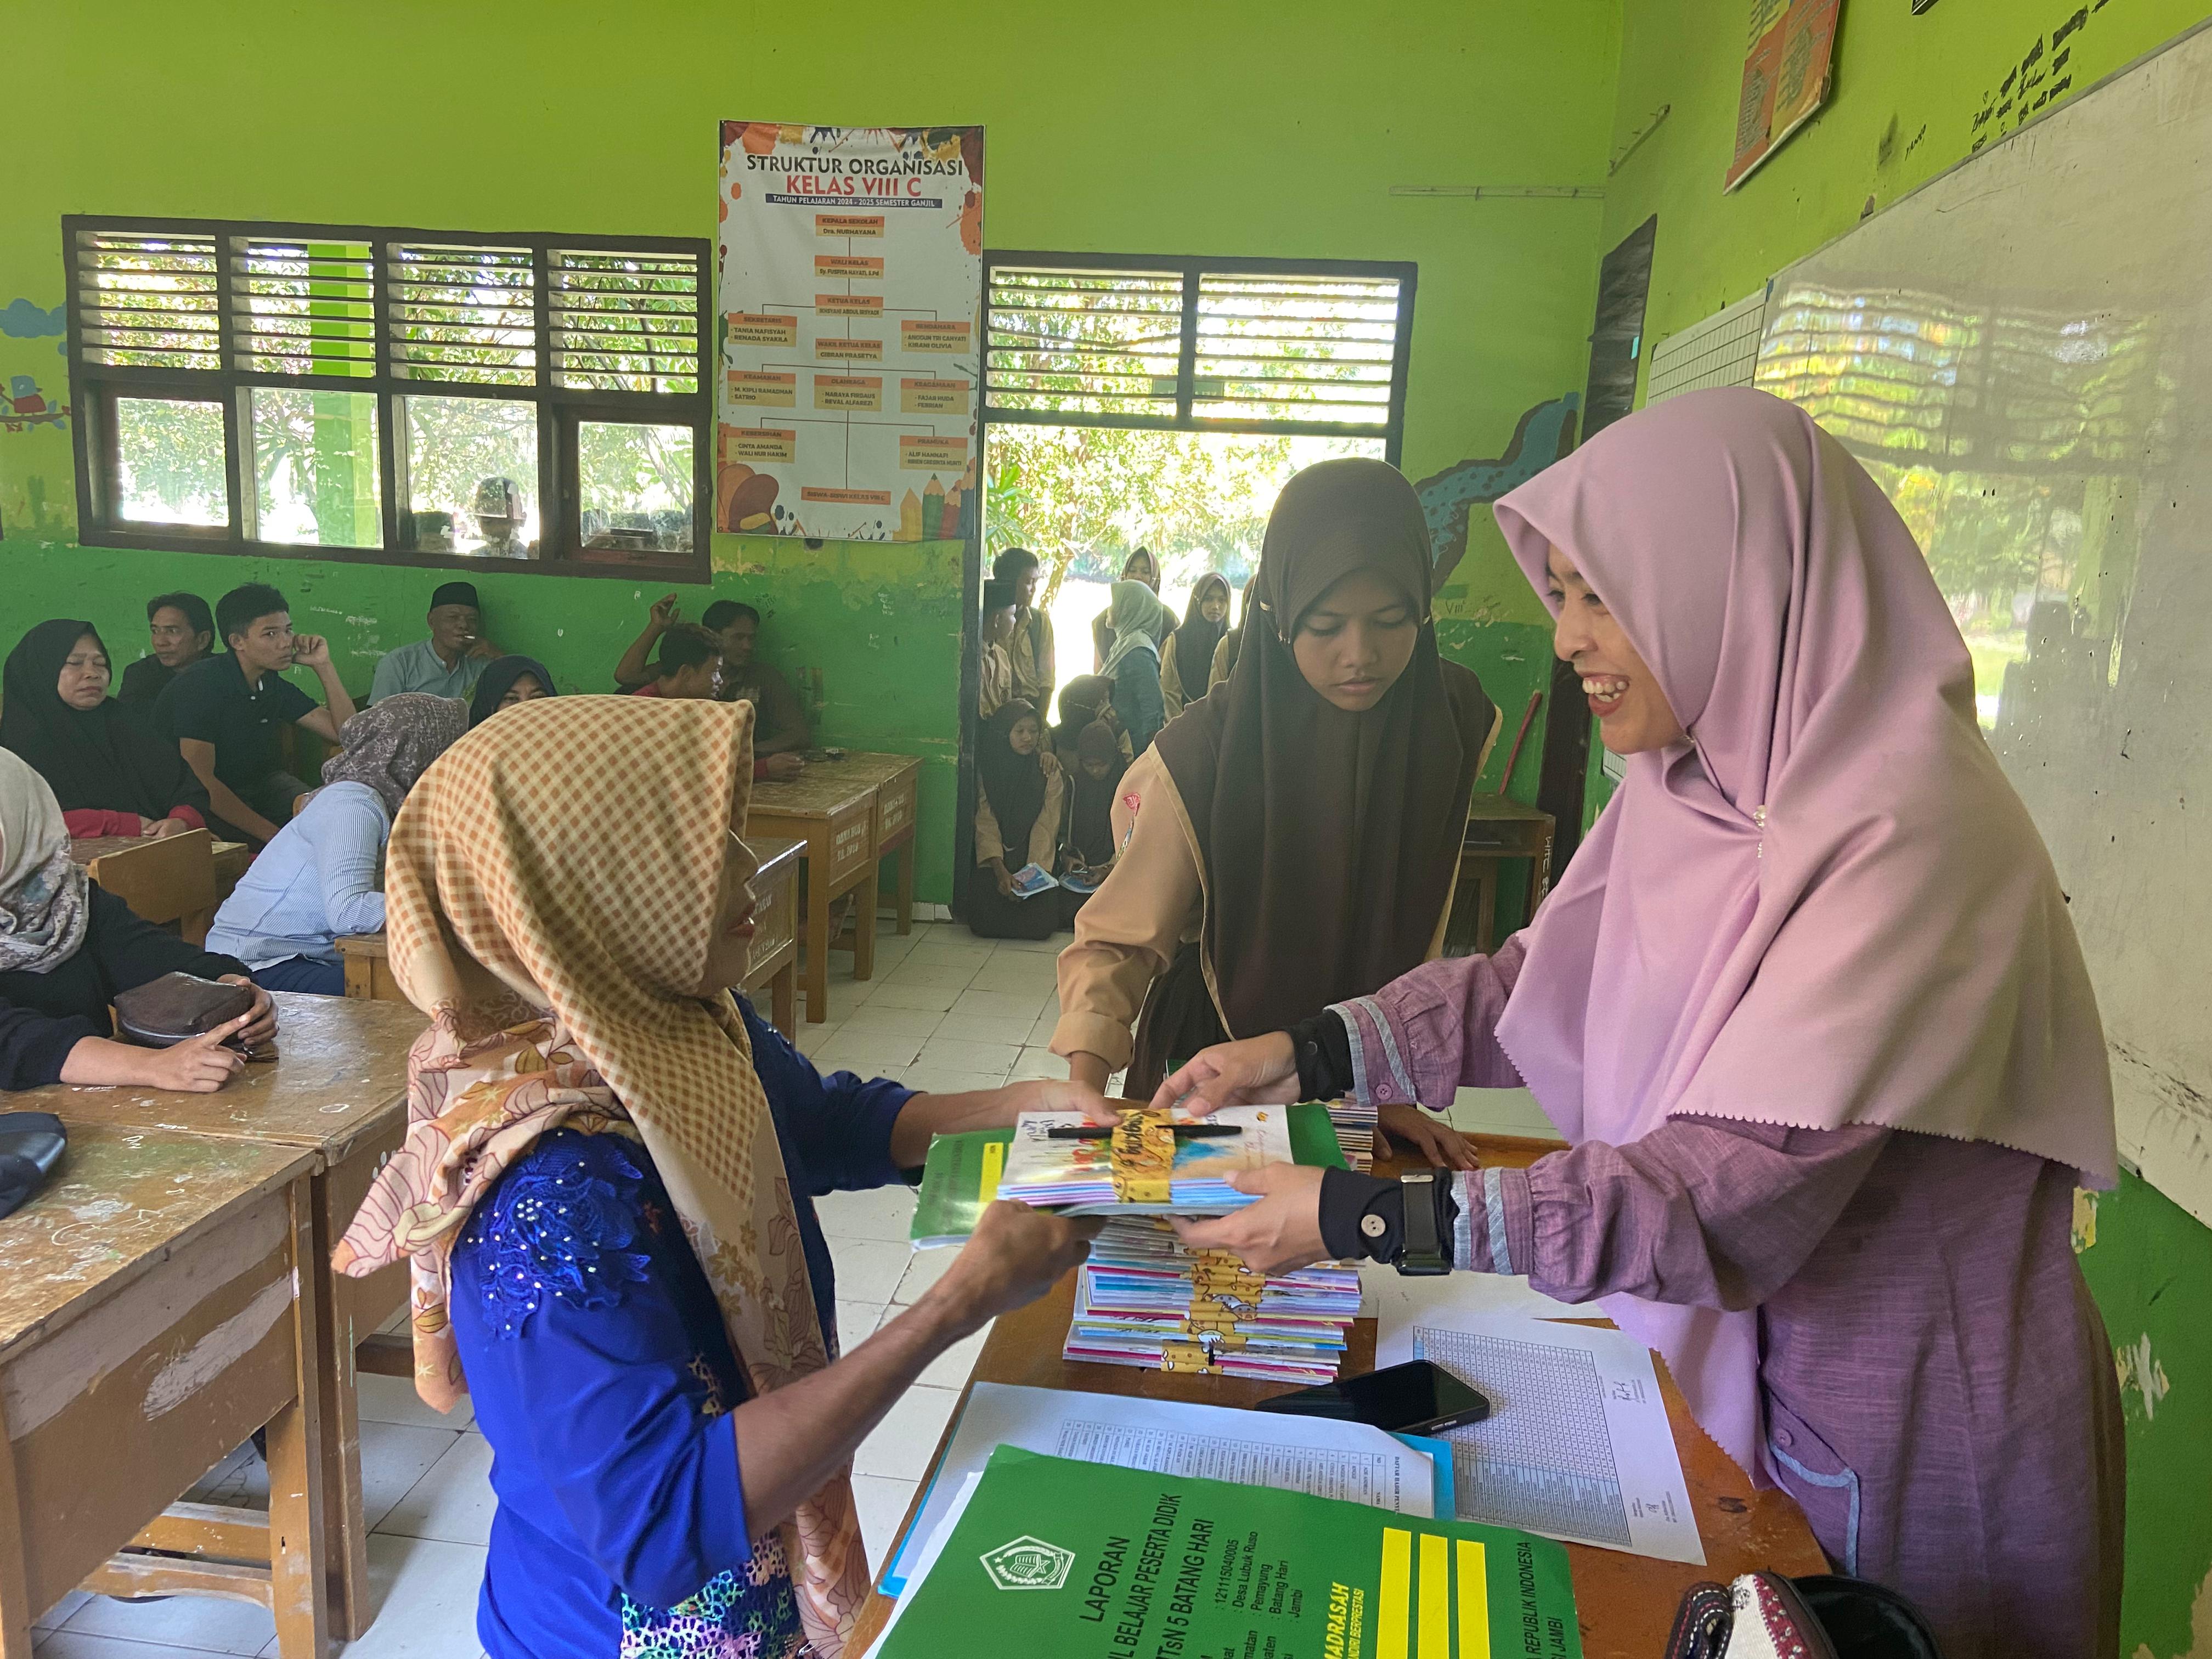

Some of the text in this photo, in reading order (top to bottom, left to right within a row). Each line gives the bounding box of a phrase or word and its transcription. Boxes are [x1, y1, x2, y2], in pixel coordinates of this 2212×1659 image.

[747, 154, 963, 176] STRUKTUR ORGANISASI
[772, 195, 797, 204] TAHUN
[876, 199, 910, 207] SEMESTER
[911, 200, 935, 208] GANJIL
[786, 174, 922, 198] KELAS VIII C
[1152, 1492, 1183, 1527] DIDIK
[1185, 1518, 1215, 1553] HARI
[1243, 1531, 1259, 1554] Ruso
[1134, 1528, 1172, 1584] PESERTA
[1214, 1538, 1239, 1604] 121115040005
[1237, 1554, 1254, 1583] Lubuk
[1275, 1559, 1289, 1580] Hari
[1078, 1536, 1131, 1623] LAPORAN
[1169, 1555, 1205, 1615] BATANG
[1232, 1583, 1249, 1609] Desa
[1250, 1563, 1274, 1612] Pemayung
[1112, 1584, 1155, 1647] BELAJAR
[1268, 1581, 1289, 1615] Batang
[1288, 1588, 1304, 1618] Jambi
[1350, 1588, 1365, 1638] BERPRESTASI
[1516, 1542, 1542, 1655] REPUBLIK INDONESIA
[1166, 1615, 1190, 1627] 5
[1547, 1617, 1566, 1652] JAMBI
